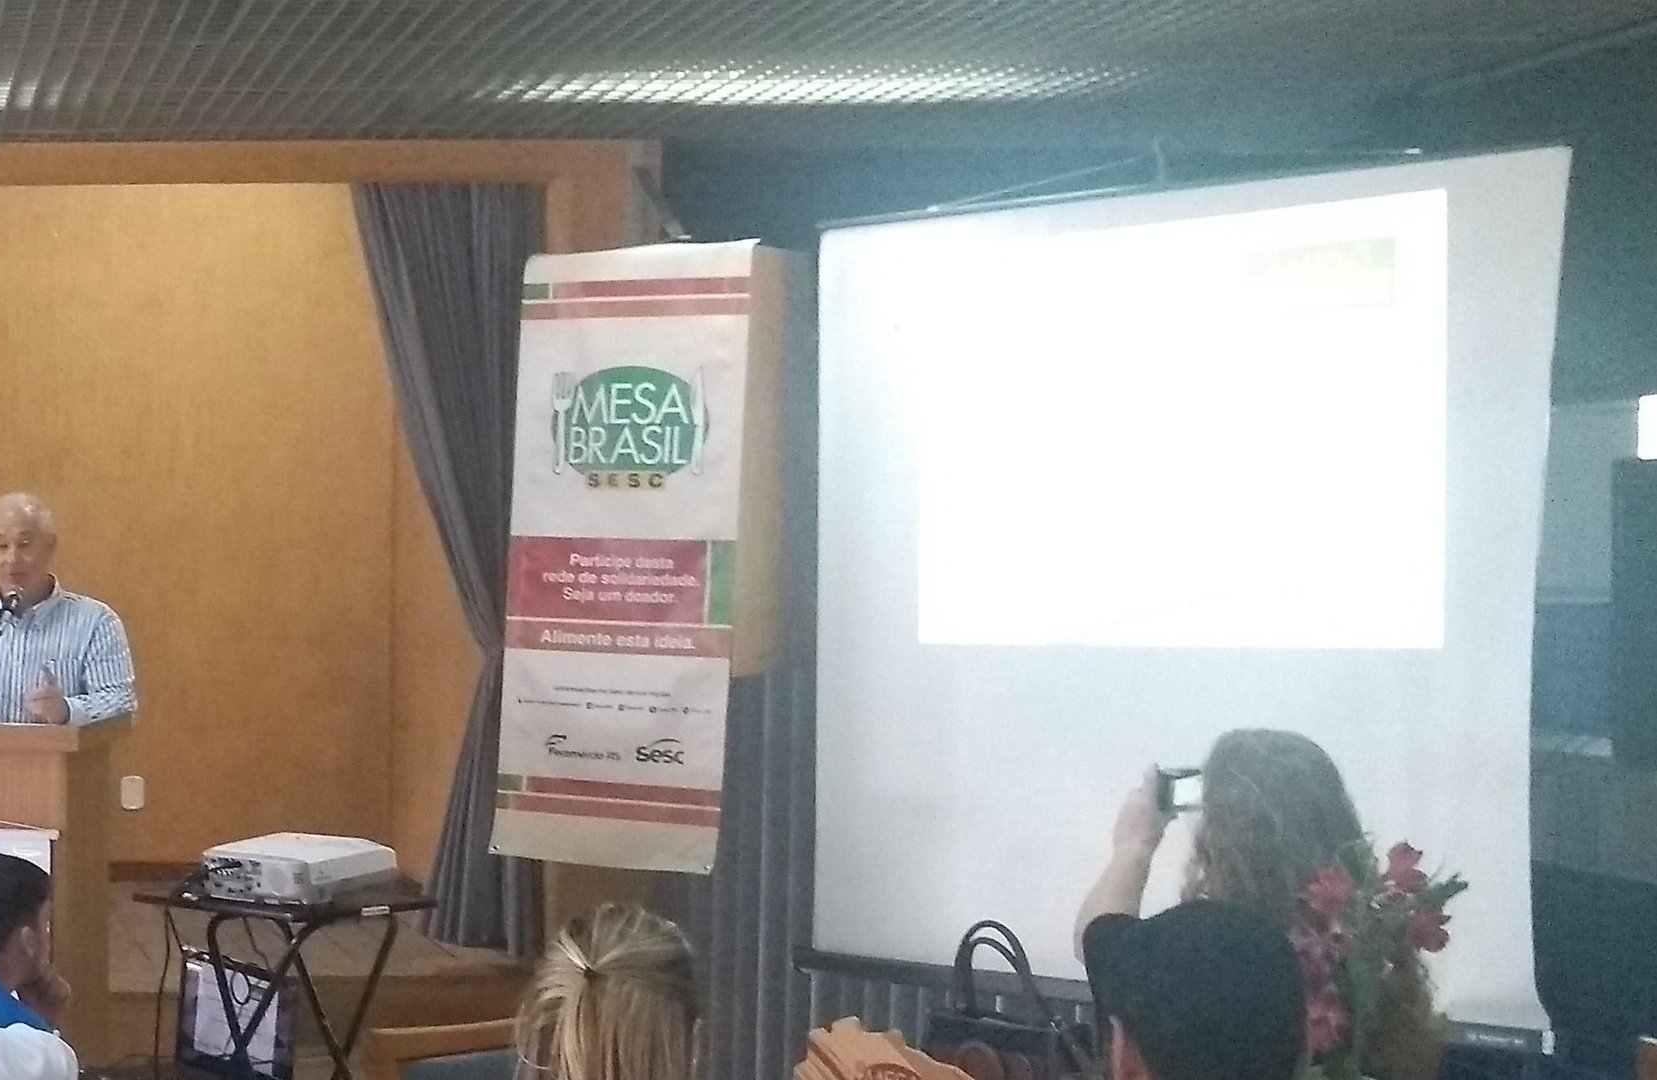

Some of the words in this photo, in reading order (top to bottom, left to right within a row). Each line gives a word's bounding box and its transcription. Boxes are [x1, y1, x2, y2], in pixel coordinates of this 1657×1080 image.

[571, 382, 689, 424] MESA
[568, 425, 688, 465] BRASIL
[588, 473, 664, 488] SESC
[543, 571, 575, 583] rede
[578, 572, 598, 584] de
[598, 591, 622, 602] um
[540, 629, 613, 647] Alimente
[616, 635, 650, 648] esta
